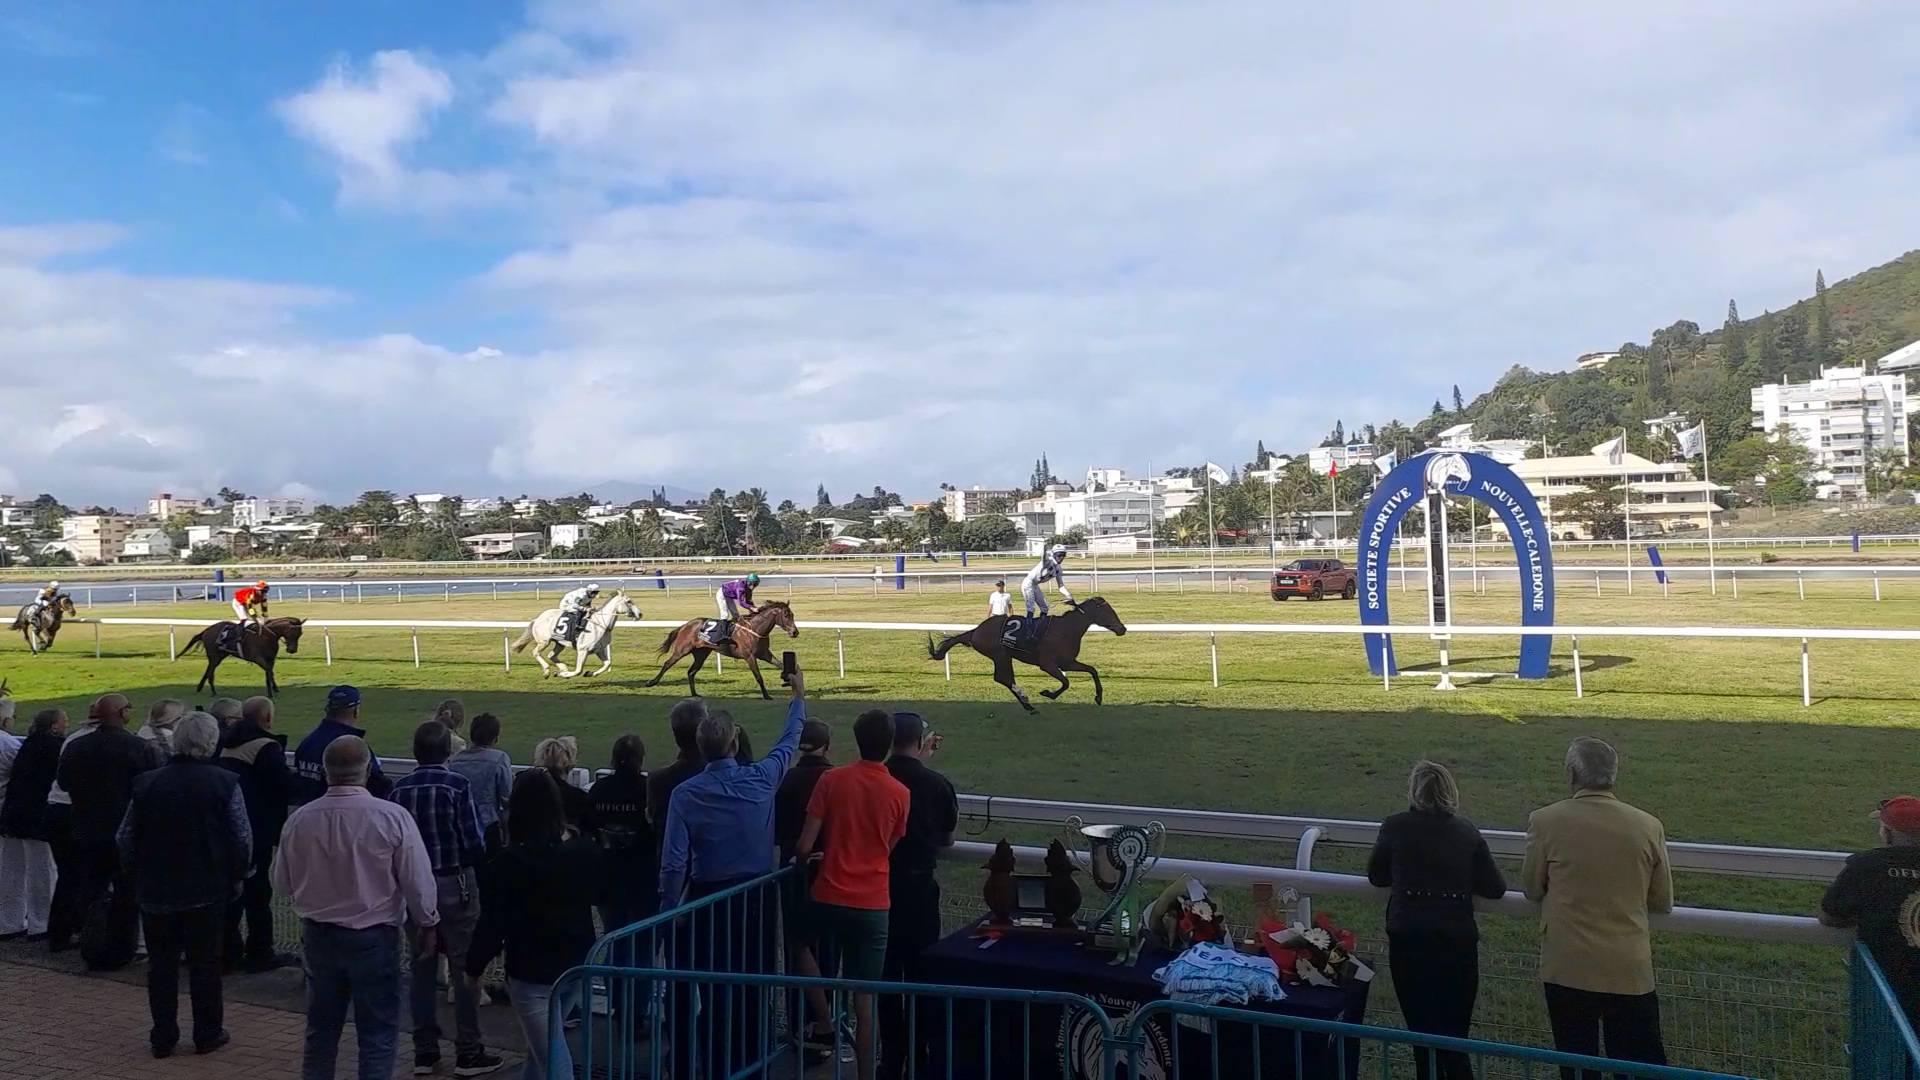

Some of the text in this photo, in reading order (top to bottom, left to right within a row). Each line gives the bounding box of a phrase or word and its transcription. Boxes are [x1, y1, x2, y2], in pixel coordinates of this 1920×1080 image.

[1366, 487, 1412, 609] SOCIETE SPORTIVE
[1480, 480, 1544, 612] NOUVELLE-CALEDONIE
[555, 616, 570, 635] 5
[704, 621, 717, 635] 7
[1003, 619, 1022, 641] 2
